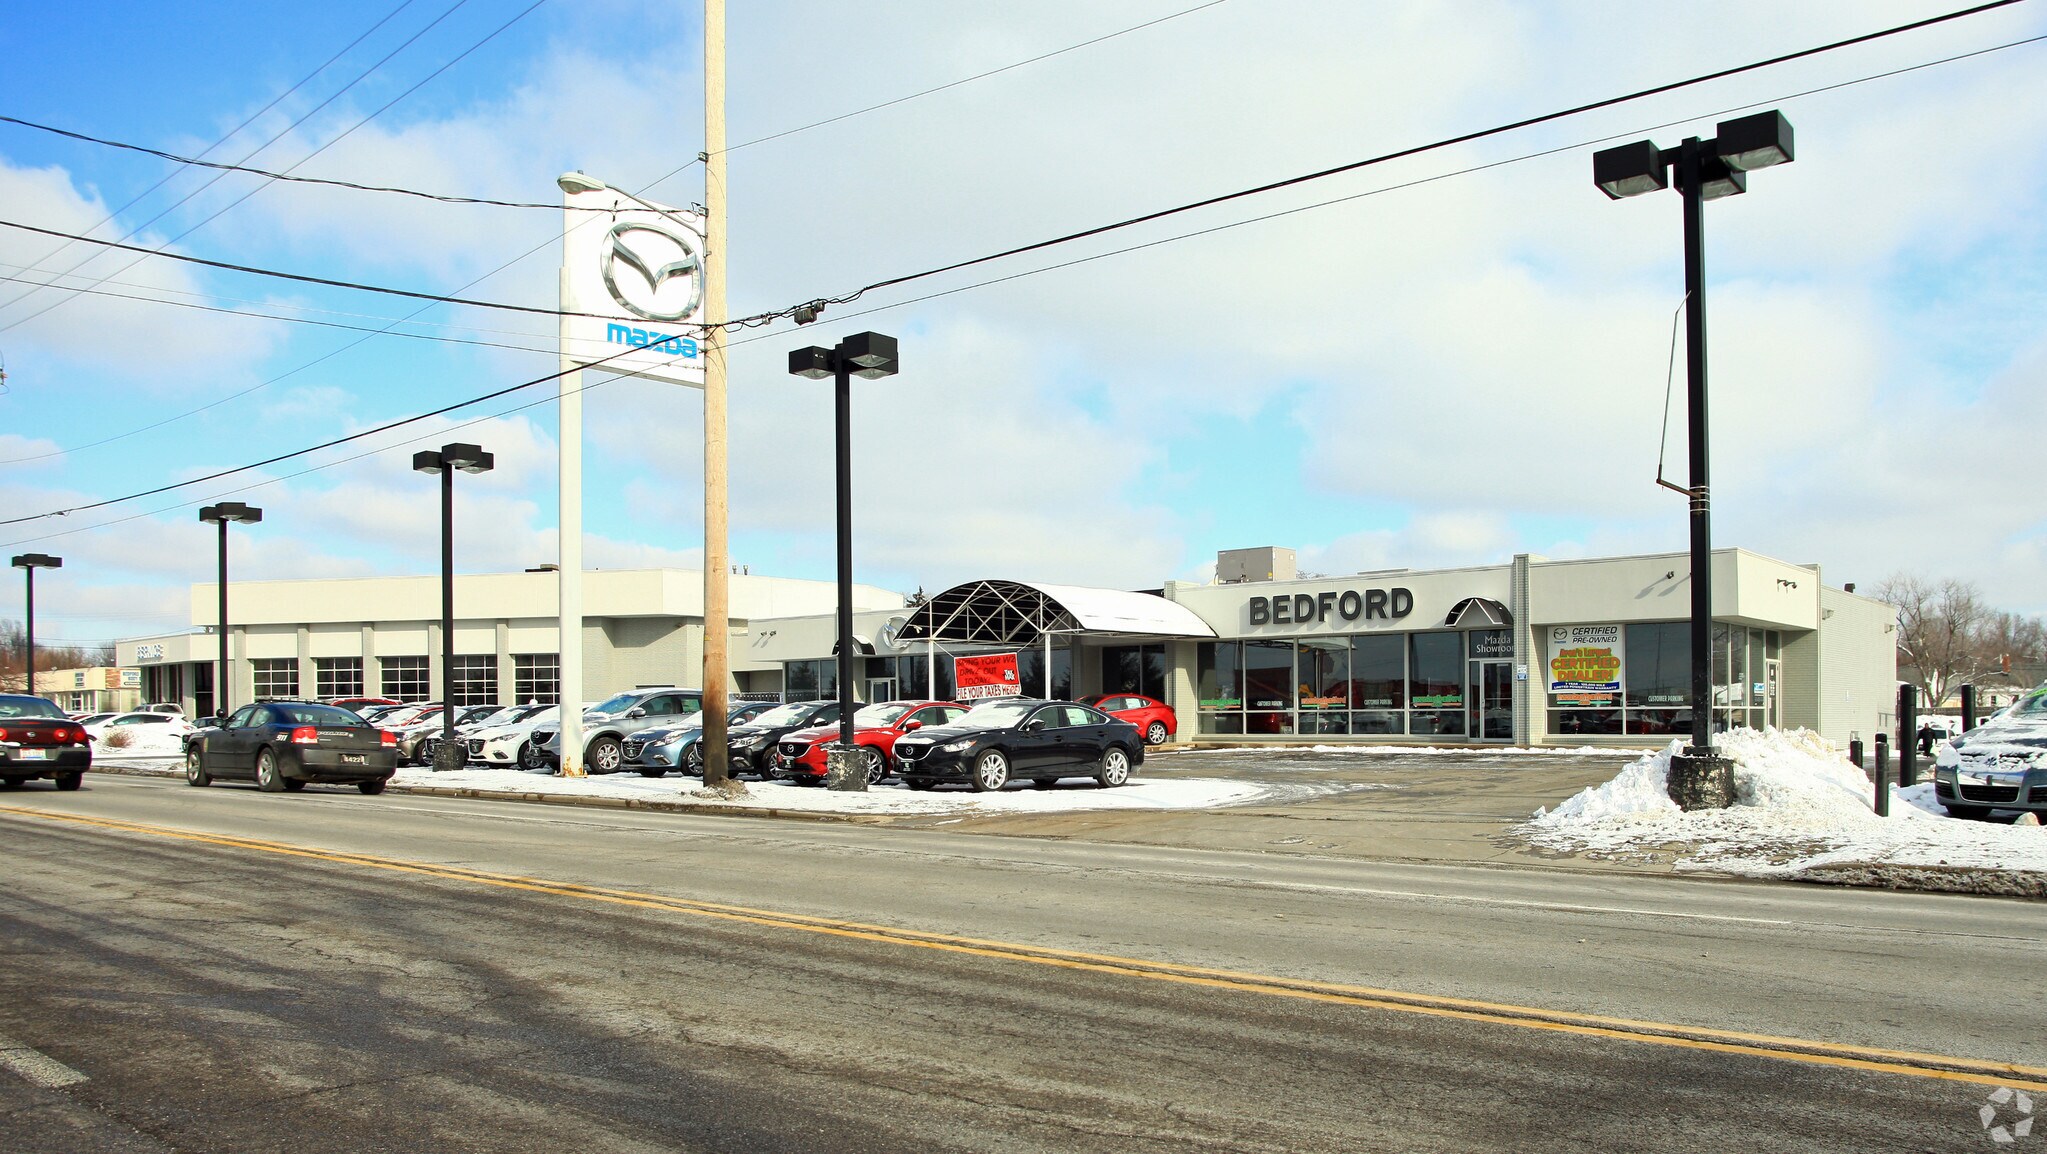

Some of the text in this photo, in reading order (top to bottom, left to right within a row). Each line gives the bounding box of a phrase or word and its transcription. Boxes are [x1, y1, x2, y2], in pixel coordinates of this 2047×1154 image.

[607, 322, 698, 359] mazda
[1249, 587, 1414, 626] BEDFORD
[1572, 626, 1617, 635] CERTIFIED
[1484, 635, 1511, 644] Mazda
[1476, 644, 1514, 653] Showroo
[1584, 647, 1611, 657] Largest
[981, 657, 1001, 665] YOUR
[1003, 655, 1016, 663] W2
[1551, 656, 1620, 670] CERTIFIED
[983, 667, 997, 675] OUT
[1557, 669, 1614, 681] DEALER!
[957, 685, 1020, 699] FILE YOUR TAXES HERE!
